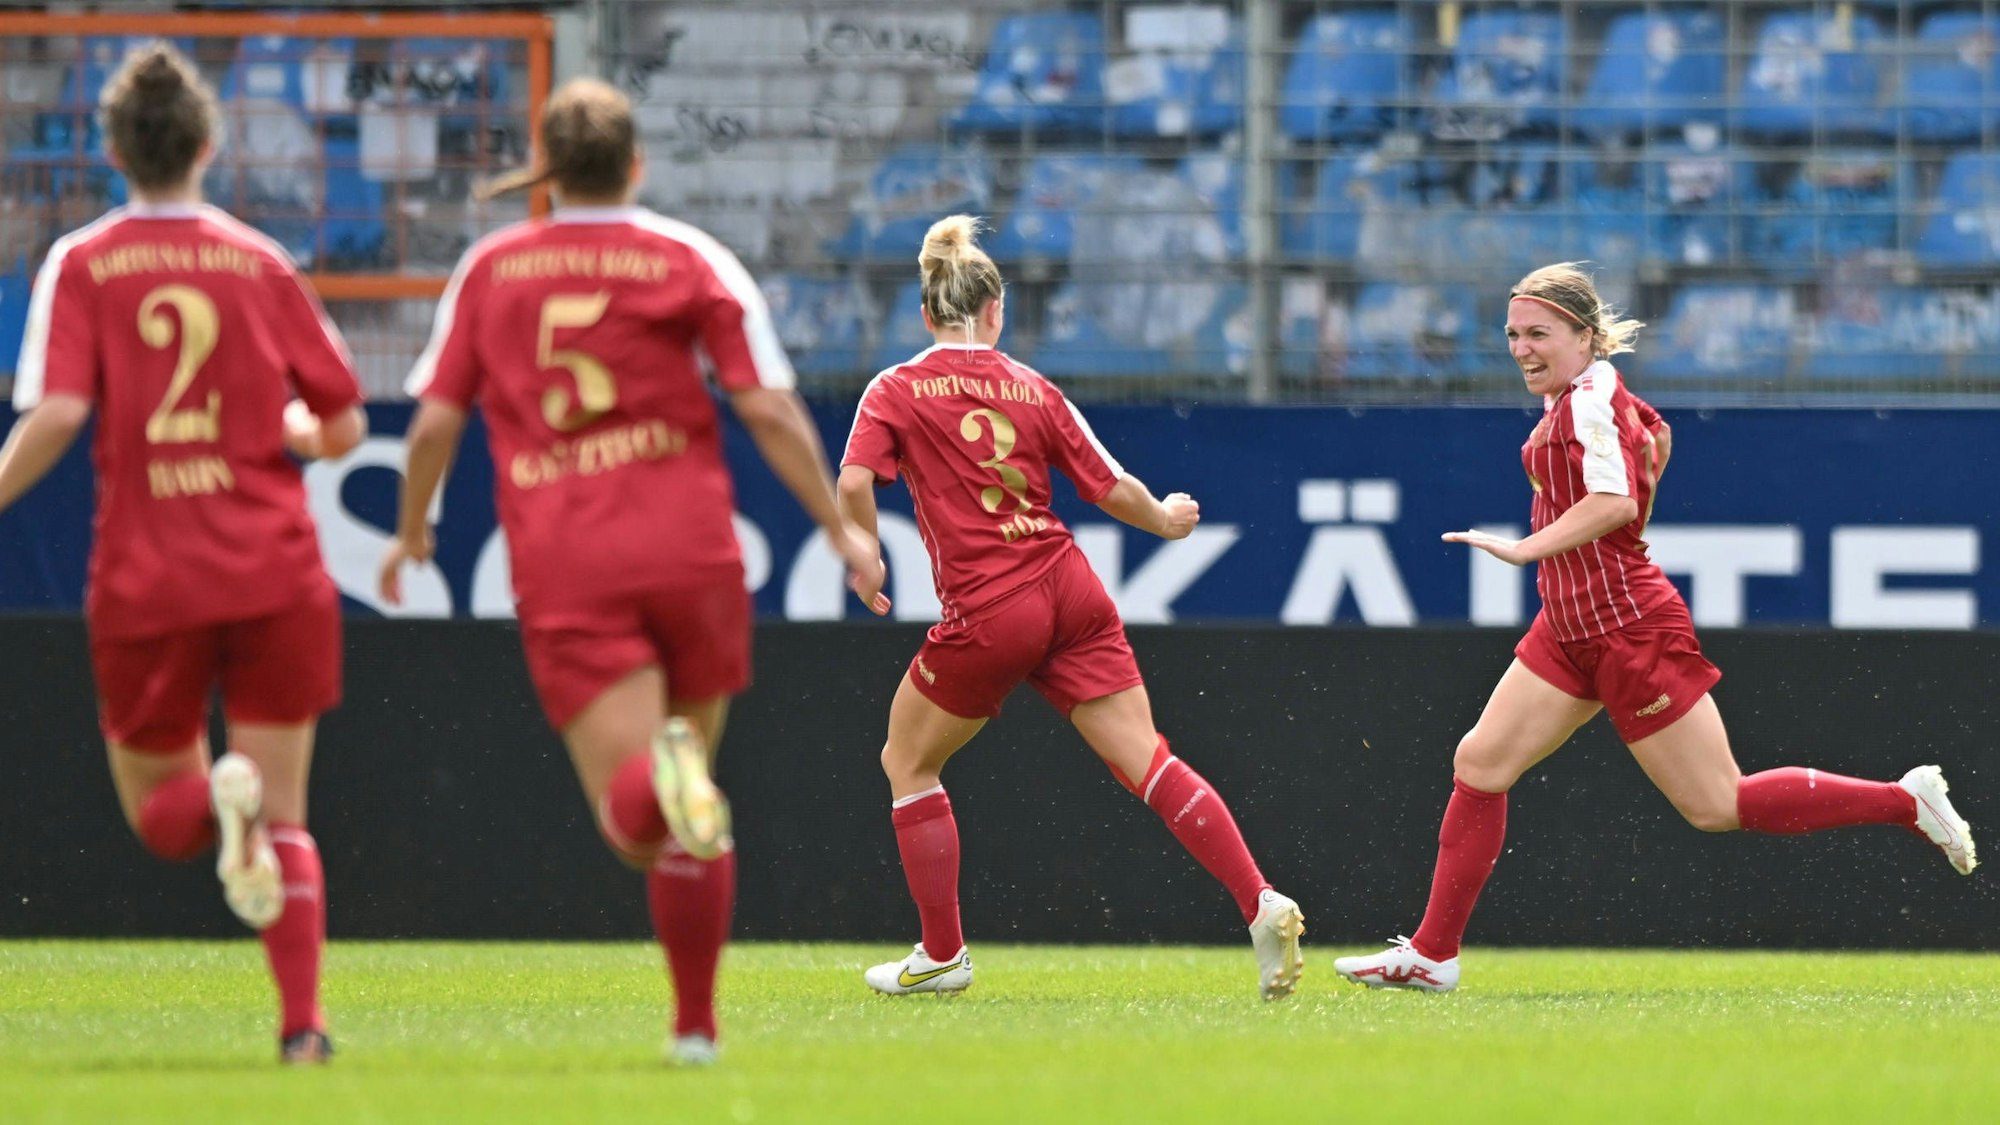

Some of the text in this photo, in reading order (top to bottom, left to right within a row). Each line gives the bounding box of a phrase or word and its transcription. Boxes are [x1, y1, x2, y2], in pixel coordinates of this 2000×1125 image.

[137, 283, 222, 445] 2
[536, 288, 618, 432] 5
[911, 375, 995, 399] FORTUNA
[959, 408, 1032, 513] 3
